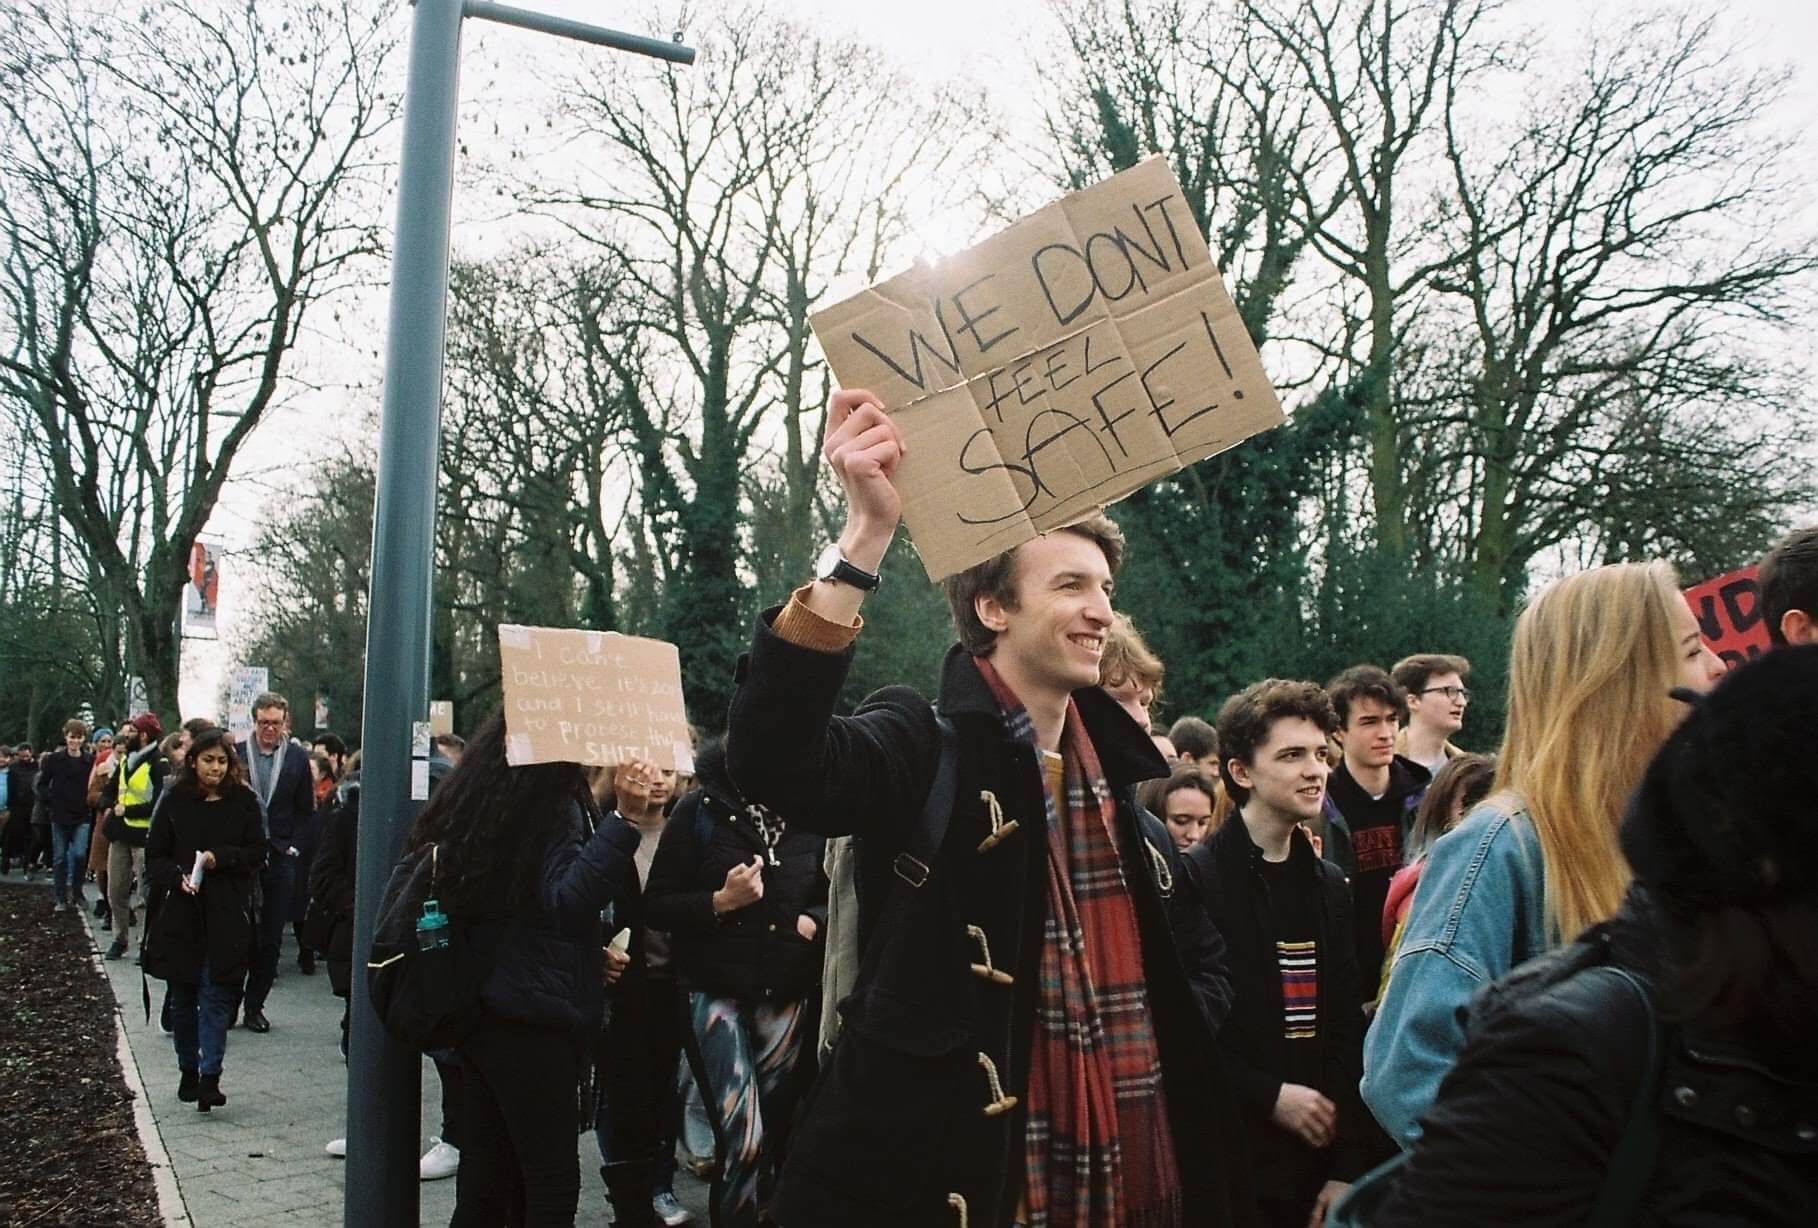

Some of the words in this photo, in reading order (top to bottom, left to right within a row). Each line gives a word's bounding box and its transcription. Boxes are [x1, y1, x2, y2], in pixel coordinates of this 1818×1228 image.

[852, 274, 1018, 390] WE
[1032, 195, 1190, 325] DONT
[957, 312, 1245, 524] SAFE!
[985, 336, 1122, 422] FEEL
[517, 697, 562, 712] and
[576, 697, 582, 713] I
[594, 699, 638, 718] still
[523, 716, 547, 731] to
